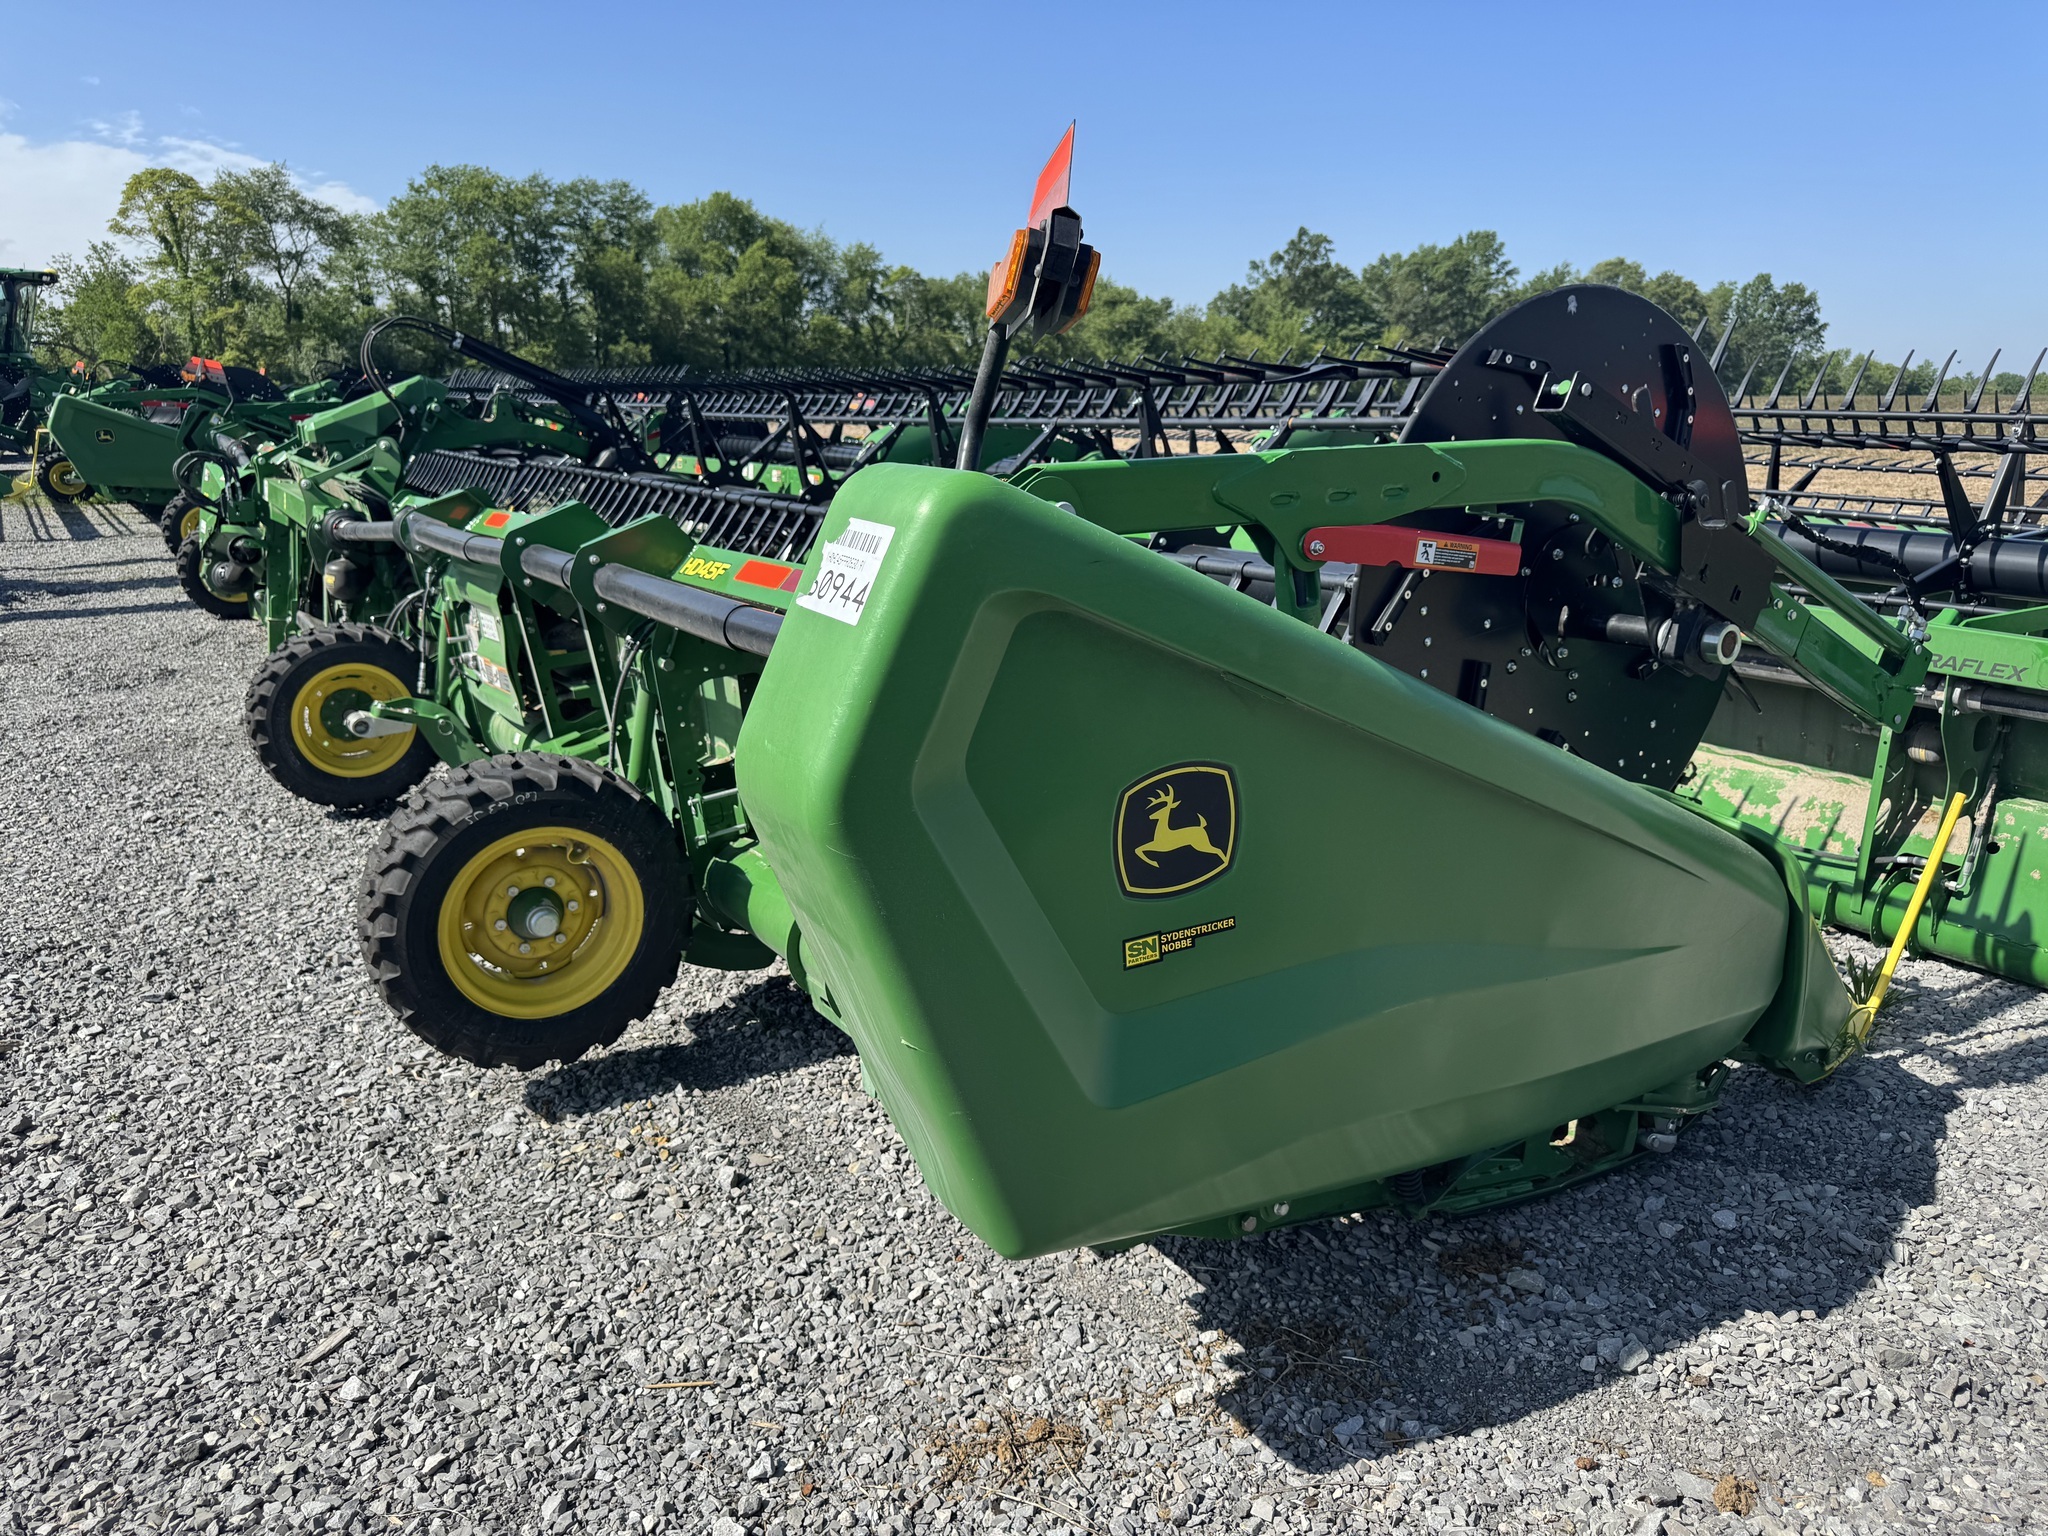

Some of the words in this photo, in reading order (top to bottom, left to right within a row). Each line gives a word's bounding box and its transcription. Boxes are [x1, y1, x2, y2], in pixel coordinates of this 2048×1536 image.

[1449, 542, 1473, 551] WARNING
[680, 556, 732, 581] HD45F
[1160, 918, 1235, 943] SYDENSTRICKER
[1161, 938, 1193, 953] NOBBE
[1128, 953, 1158, 965] PARTNERS
